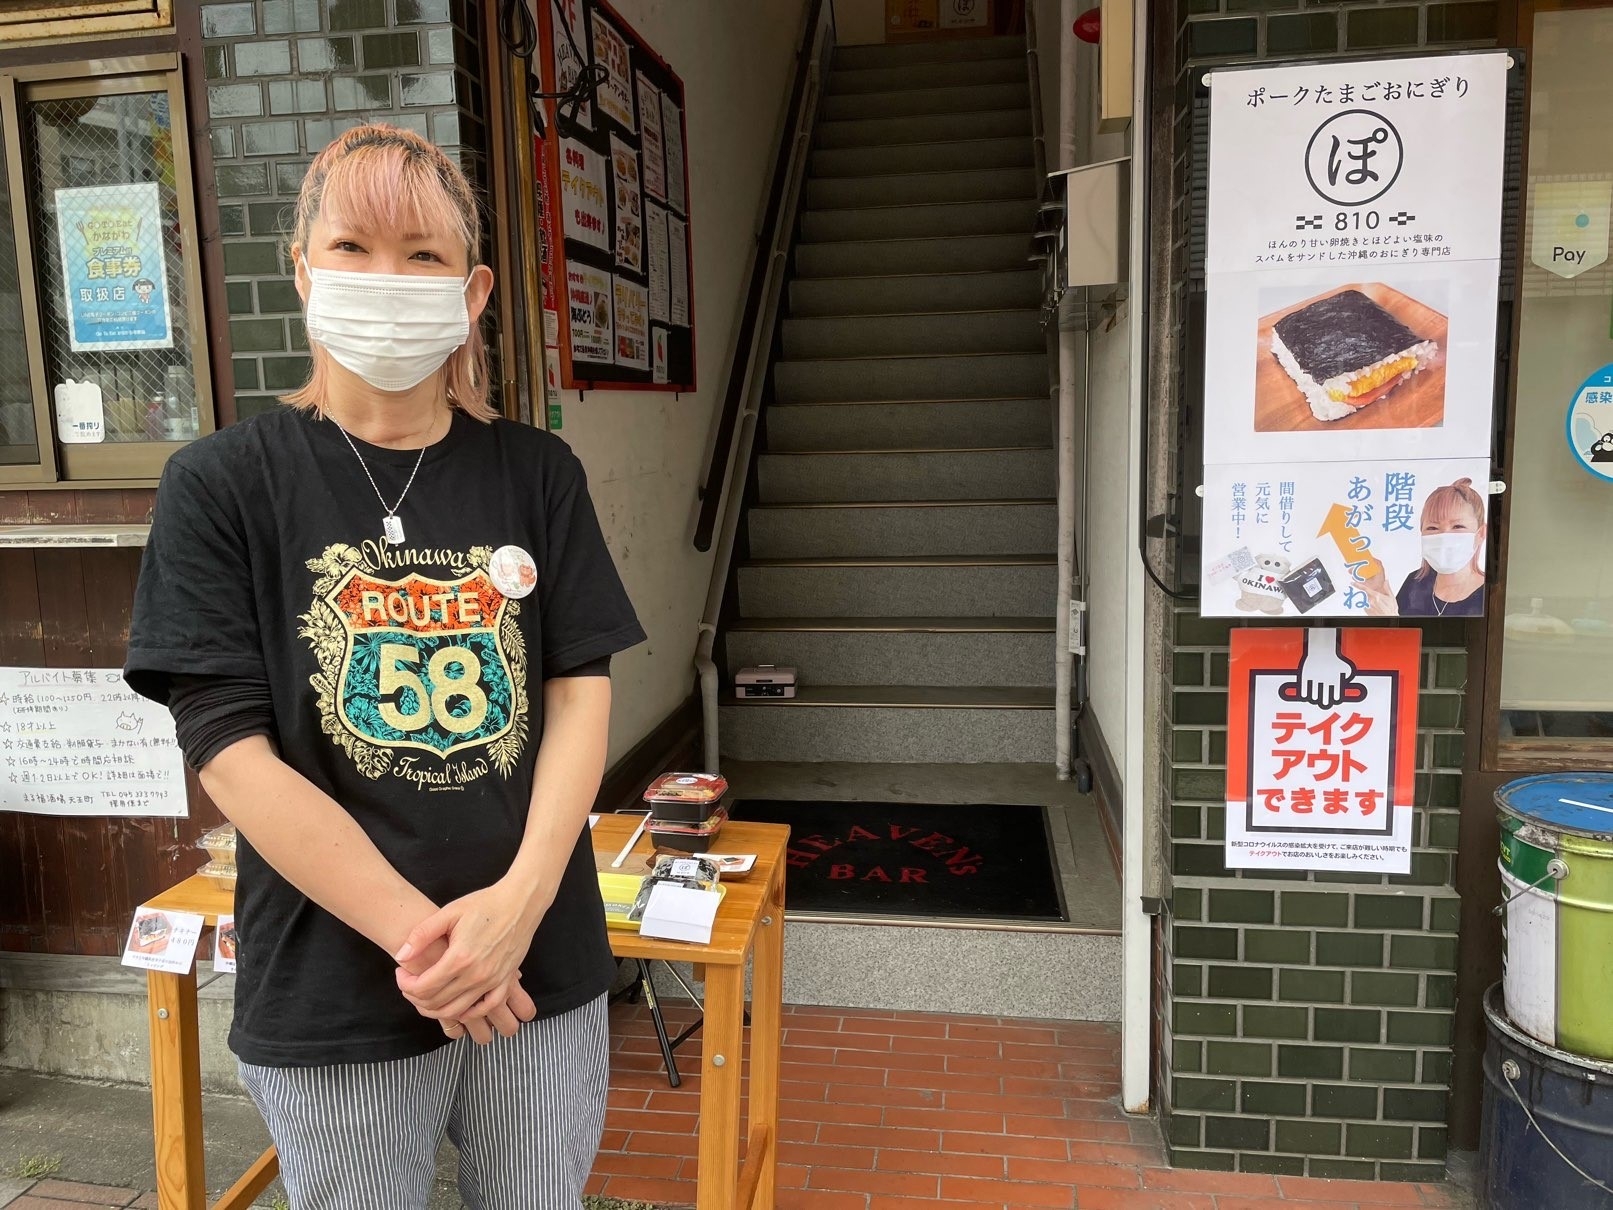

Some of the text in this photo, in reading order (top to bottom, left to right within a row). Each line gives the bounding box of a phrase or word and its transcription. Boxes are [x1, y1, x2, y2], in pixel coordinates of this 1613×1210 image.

[1246, 76, 1470, 108] ポークたまごおにぎり
[1327, 127, 1389, 187] ぽ
[1334, 211, 1380, 231] 810
[93, 231, 131, 243] かながわ
[1268, 234, 1443, 250] ほんのり甘い卵焼きとほどよい塩味の
[86, 256, 141, 279] 食事券
[1255, 246, 1451, 263] スパムをサンドした沖縄のおにぎり専門店
[1553, 246, 1586, 265] Pay
[80, 287, 126, 302] 取扱店
[1585, 391, 1613, 404] 感染
[1255, 482, 1271, 525] 元気に
[1279, 481, 1294, 553] 間借りして
[1382, 472, 1416, 532] 階段
[361, 536, 468, 571] Okinawa
[1343, 476, 1373, 610] あがってね
[361, 590, 482, 627] ROUTE
[19, 670, 96, 686] アルバイト募集
[377, 643, 488, 734] 58
[16, 722, 56, 732] 18才以上
[1271, 712, 1374, 746] テイク
[393, 756, 489, 791] Tropical Island
[1271, 749, 1368, 782] アウト
[1256, 787, 1384, 816] できます
[827, 863, 930, 884] BAR
